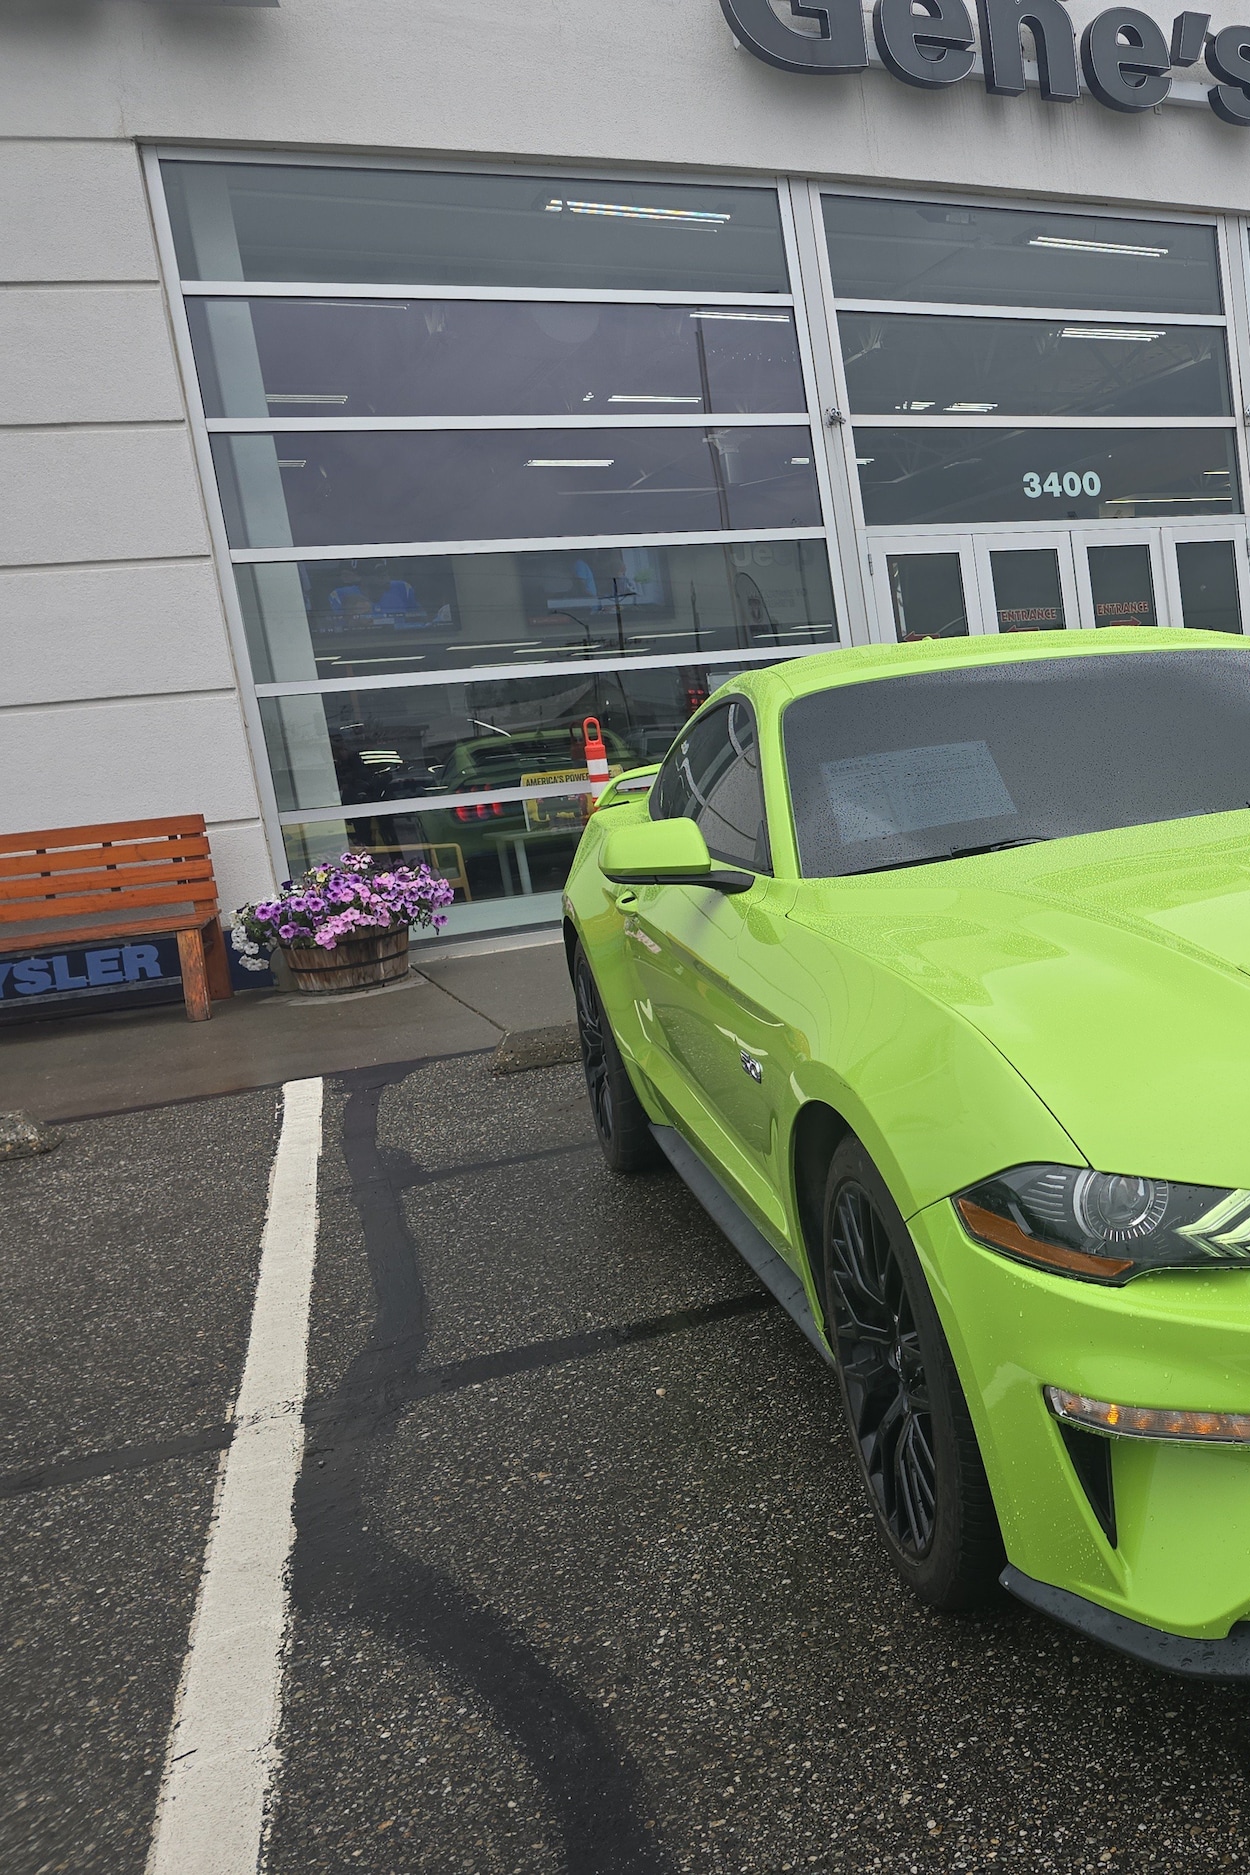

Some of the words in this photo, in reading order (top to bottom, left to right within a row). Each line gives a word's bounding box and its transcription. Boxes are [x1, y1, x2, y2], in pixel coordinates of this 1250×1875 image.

[1022, 470, 1102, 499] 3400
[1000, 607, 1057, 622] ENTRANCE
[1096, 600, 1149, 616] ENTRANCE
[526, 774, 565, 787] AMERICA'S
